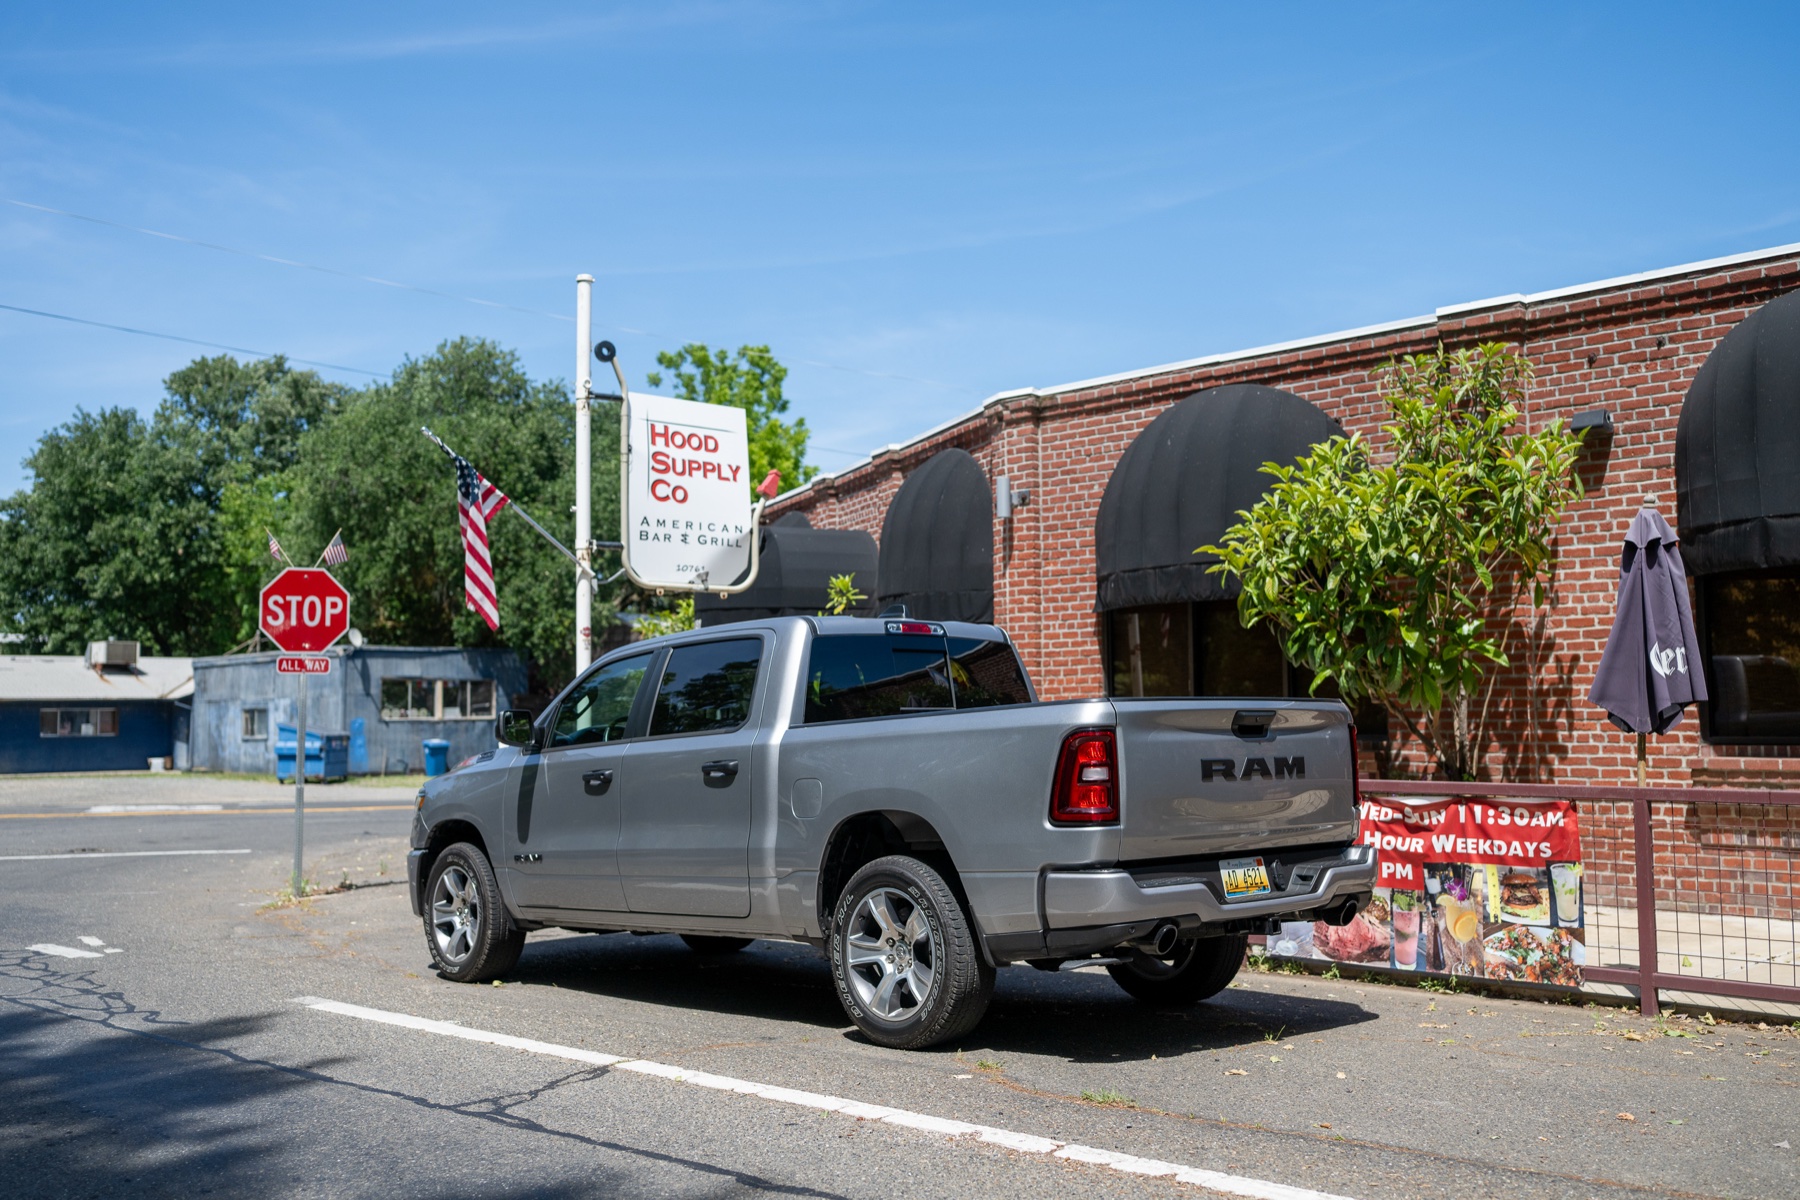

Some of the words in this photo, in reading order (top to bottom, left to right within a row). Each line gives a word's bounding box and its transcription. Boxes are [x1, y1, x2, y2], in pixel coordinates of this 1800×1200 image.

[650, 423, 719, 453] HOOD
[651, 451, 741, 482] SUPPLY
[640, 516, 744, 534] AMERICAN
[639, 530, 672, 543] BAR
[697, 534, 742, 548] GRILL
[266, 594, 344, 627] STOP
[280, 660, 301, 671] ALL
[305, 660, 327, 671] WAY
[1200, 756, 1306, 782] RAM
[1364, 830, 1424, 854] HOUR
[1432, 833, 1553, 859] WEEKDAYS
[1243, 866, 1264, 887] 4521
[1381, 861, 1414, 880] PM
